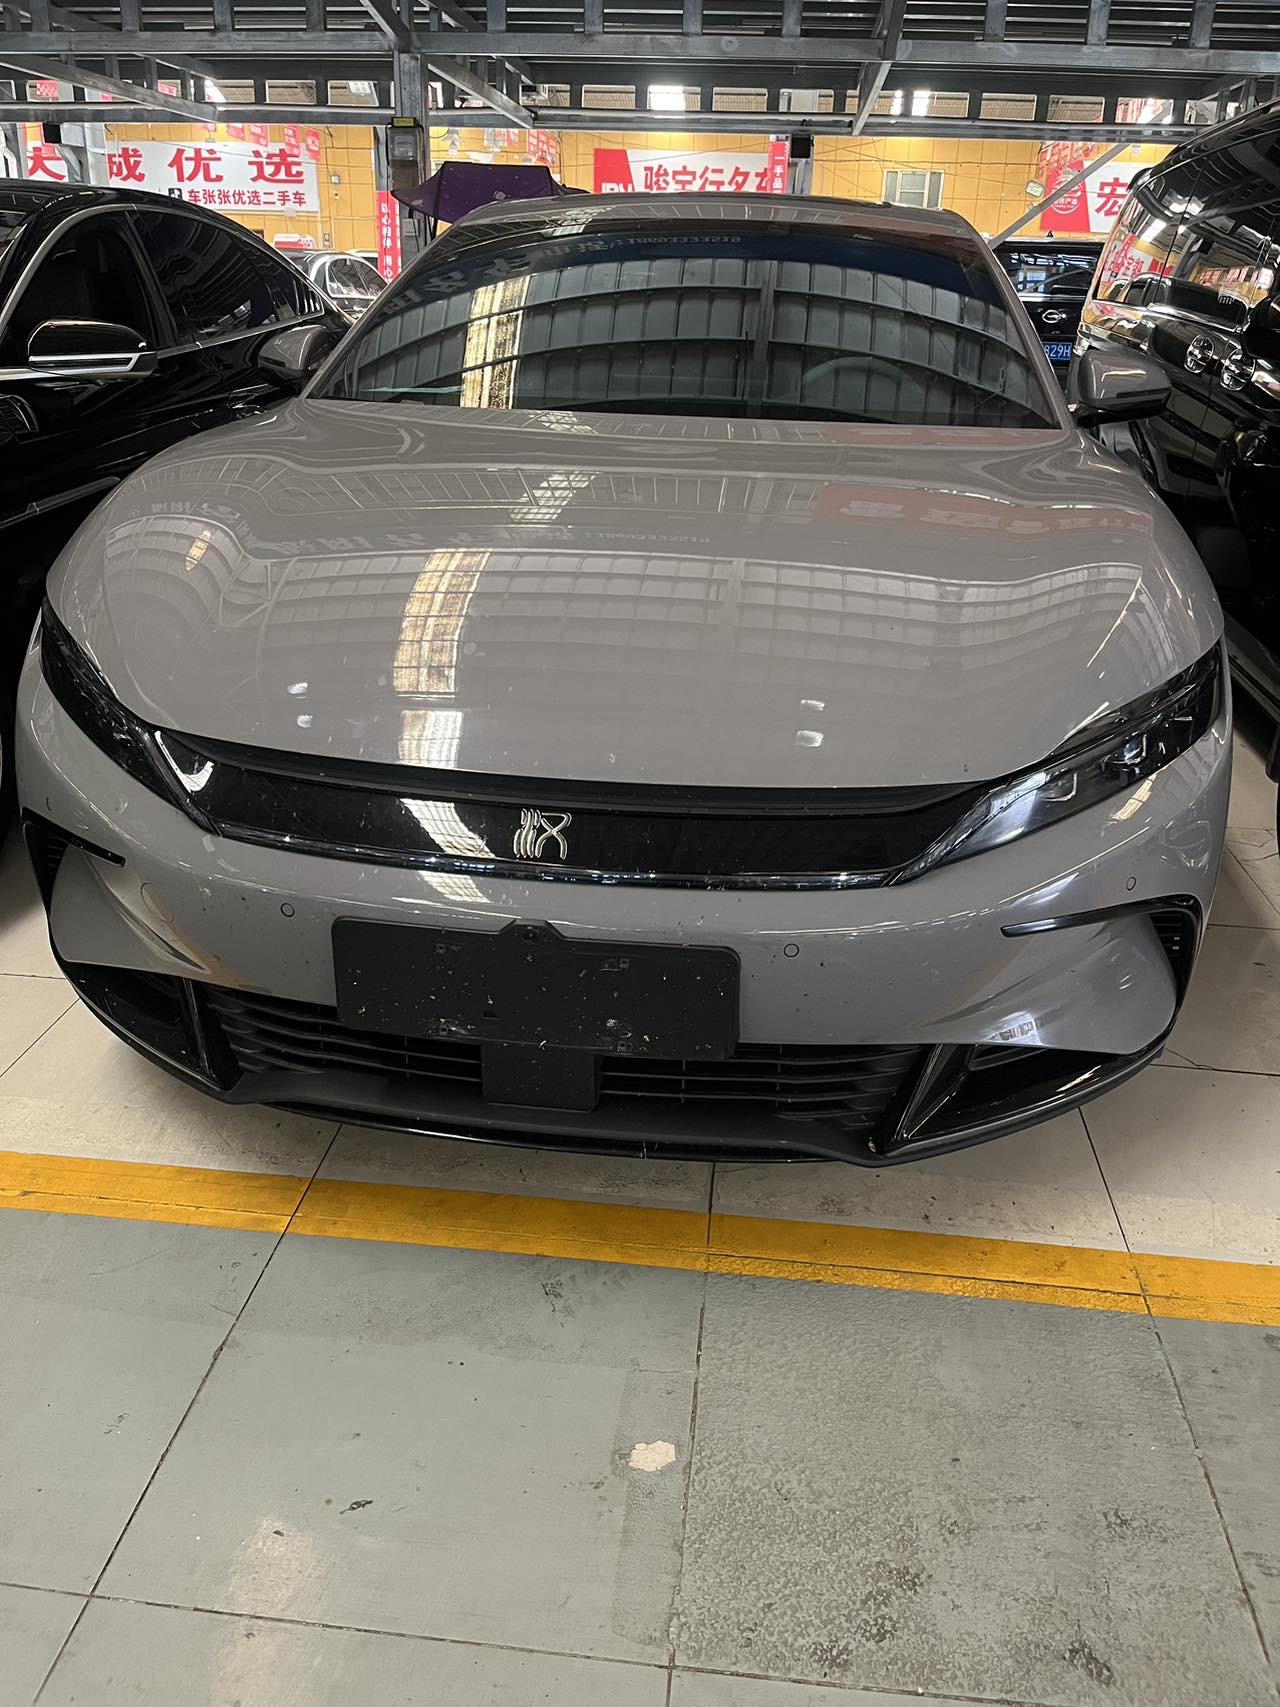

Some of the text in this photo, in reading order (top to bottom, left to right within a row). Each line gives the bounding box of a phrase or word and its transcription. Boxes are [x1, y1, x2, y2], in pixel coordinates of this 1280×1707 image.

[188, 188, 307, 207] 车张张优选二手车
